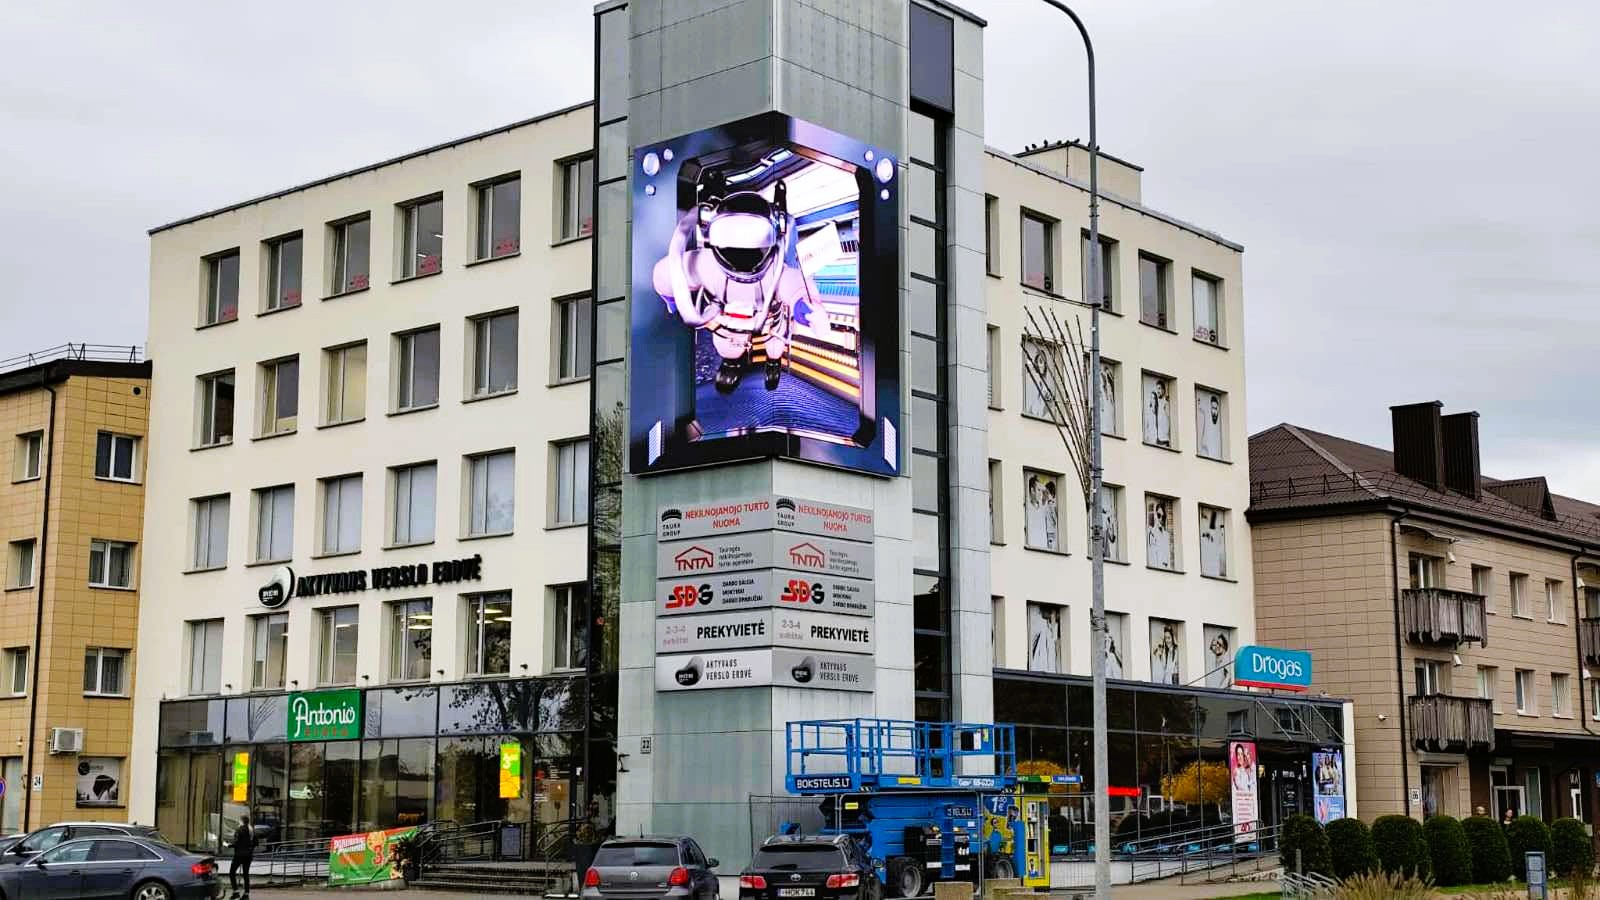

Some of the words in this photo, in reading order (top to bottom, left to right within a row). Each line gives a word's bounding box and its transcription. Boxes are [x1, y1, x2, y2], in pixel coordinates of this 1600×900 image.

[744, 501, 769, 512] TURTO
[712, 518, 740, 529] NUOMA
[850, 512, 871, 524] TURTO
[823, 521, 847, 531] NUOMA
[296, 570, 367, 598] AKTYVAUS
[371, 563, 428, 590] VERSLO
[665, 584, 713, 609] SDG
[780, 579, 825, 604] SDG
[697, 618, 765, 639] PREKYVIETĖ
[810, 625, 869, 643] PREKYVIETĖ
[706, 659, 737, 668] AKTYVAUS
[1252, 652, 1303, 680] Drogas
[706, 671, 730, 681] VERSLO
[292, 697, 356, 739] Antonio
[796, 777, 850, 789] BOKSTELIS.LT
